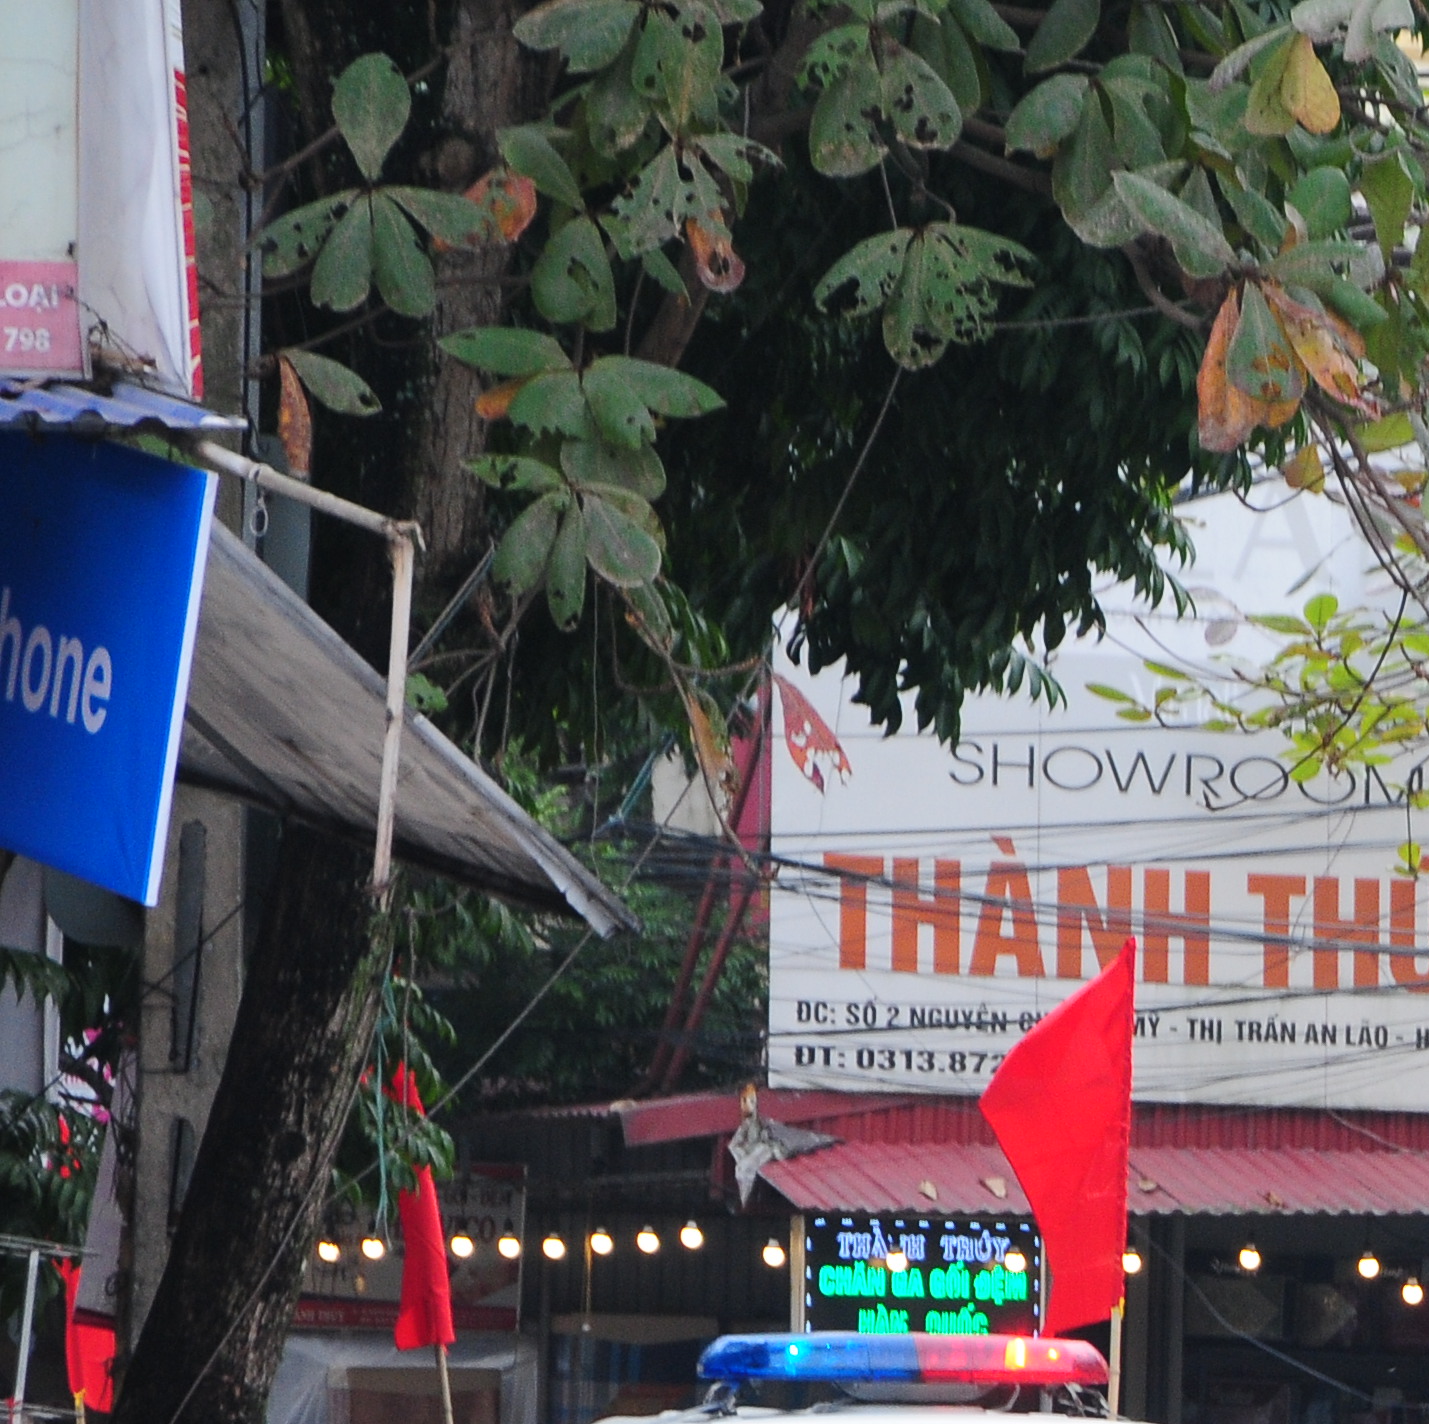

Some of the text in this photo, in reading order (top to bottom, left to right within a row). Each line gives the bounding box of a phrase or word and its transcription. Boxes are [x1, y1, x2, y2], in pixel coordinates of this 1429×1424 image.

[949, 741, 1424, 805] SHOWROOM
[824, 833, 1210, 984] THÀNH
[887, 1006, 900, 1028] 2
[1305, 1023, 1337, 1045] AN
